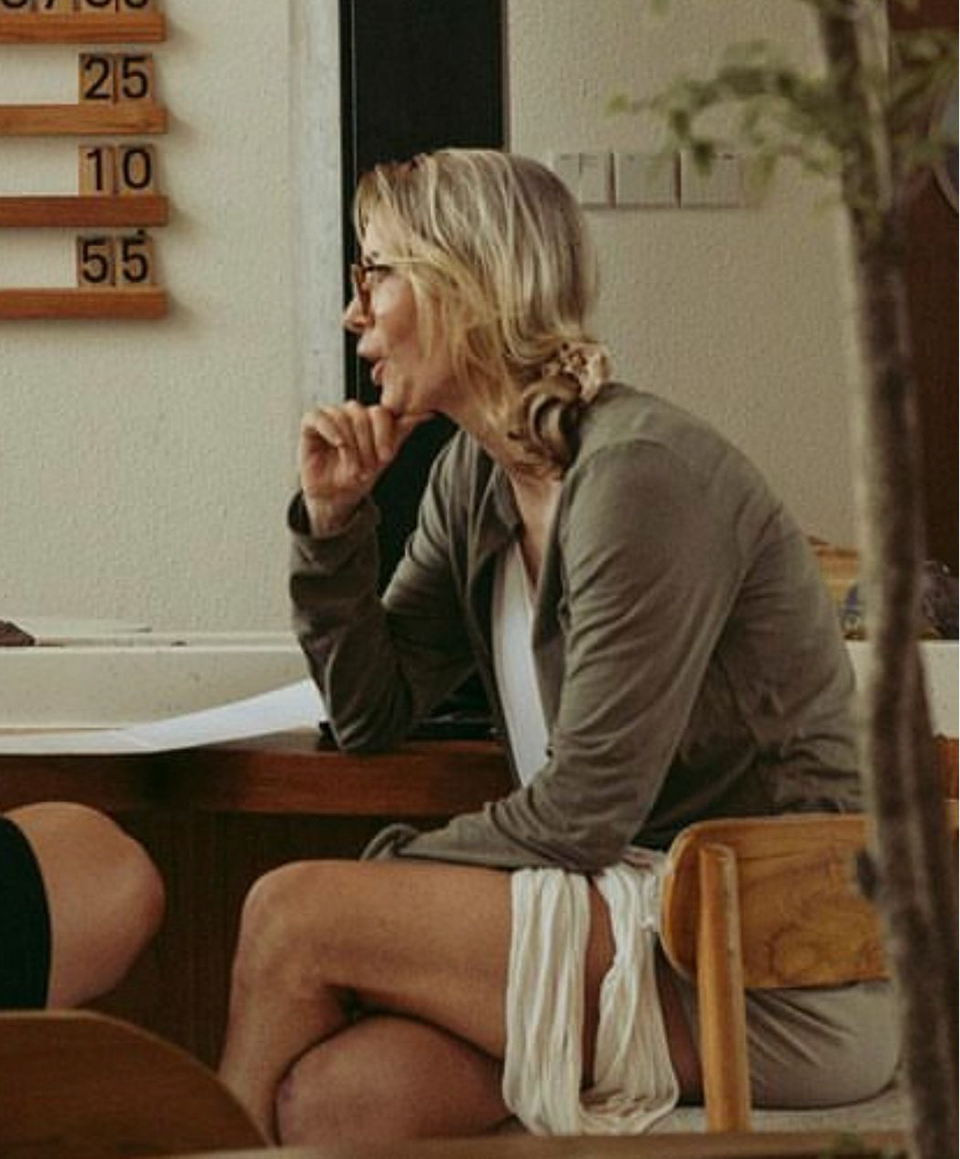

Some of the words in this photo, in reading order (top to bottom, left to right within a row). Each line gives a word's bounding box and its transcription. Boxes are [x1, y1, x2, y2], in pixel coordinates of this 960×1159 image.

[84, 56, 149, 101] 25
[86, 149, 151, 191] 10
[82, 239, 148, 284] 55
